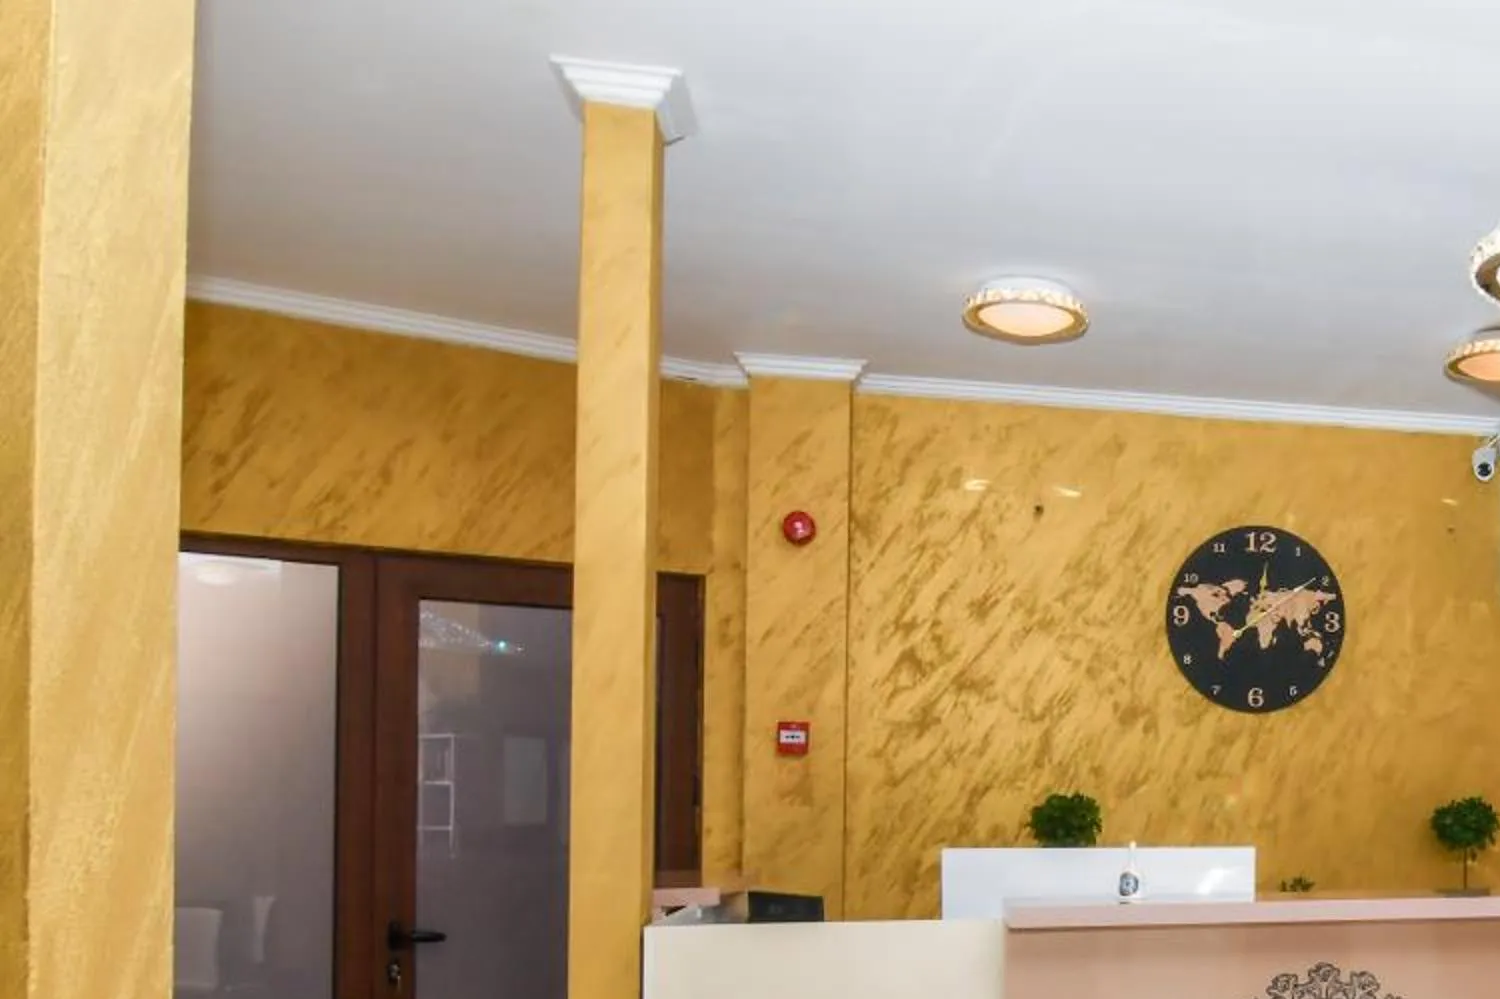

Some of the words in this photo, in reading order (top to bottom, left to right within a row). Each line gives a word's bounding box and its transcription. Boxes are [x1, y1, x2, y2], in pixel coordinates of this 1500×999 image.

[1213, 542, 1226, 553] 11
[1245, 531, 1277, 553] 12
[1183, 572, 1199, 583] 10
[1321, 576, 1330, 587] 2
[1173, 605, 1190, 627] 9
[1325, 611, 1341, 633] 3
[1183, 655, 1192, 665] 8
[1317, 657, 1326, 668] 4
[1211, 685, 1221, 696] 7
[1289, 686, 1298, 697] 5
[1247, 687, 1265, 708] 6
